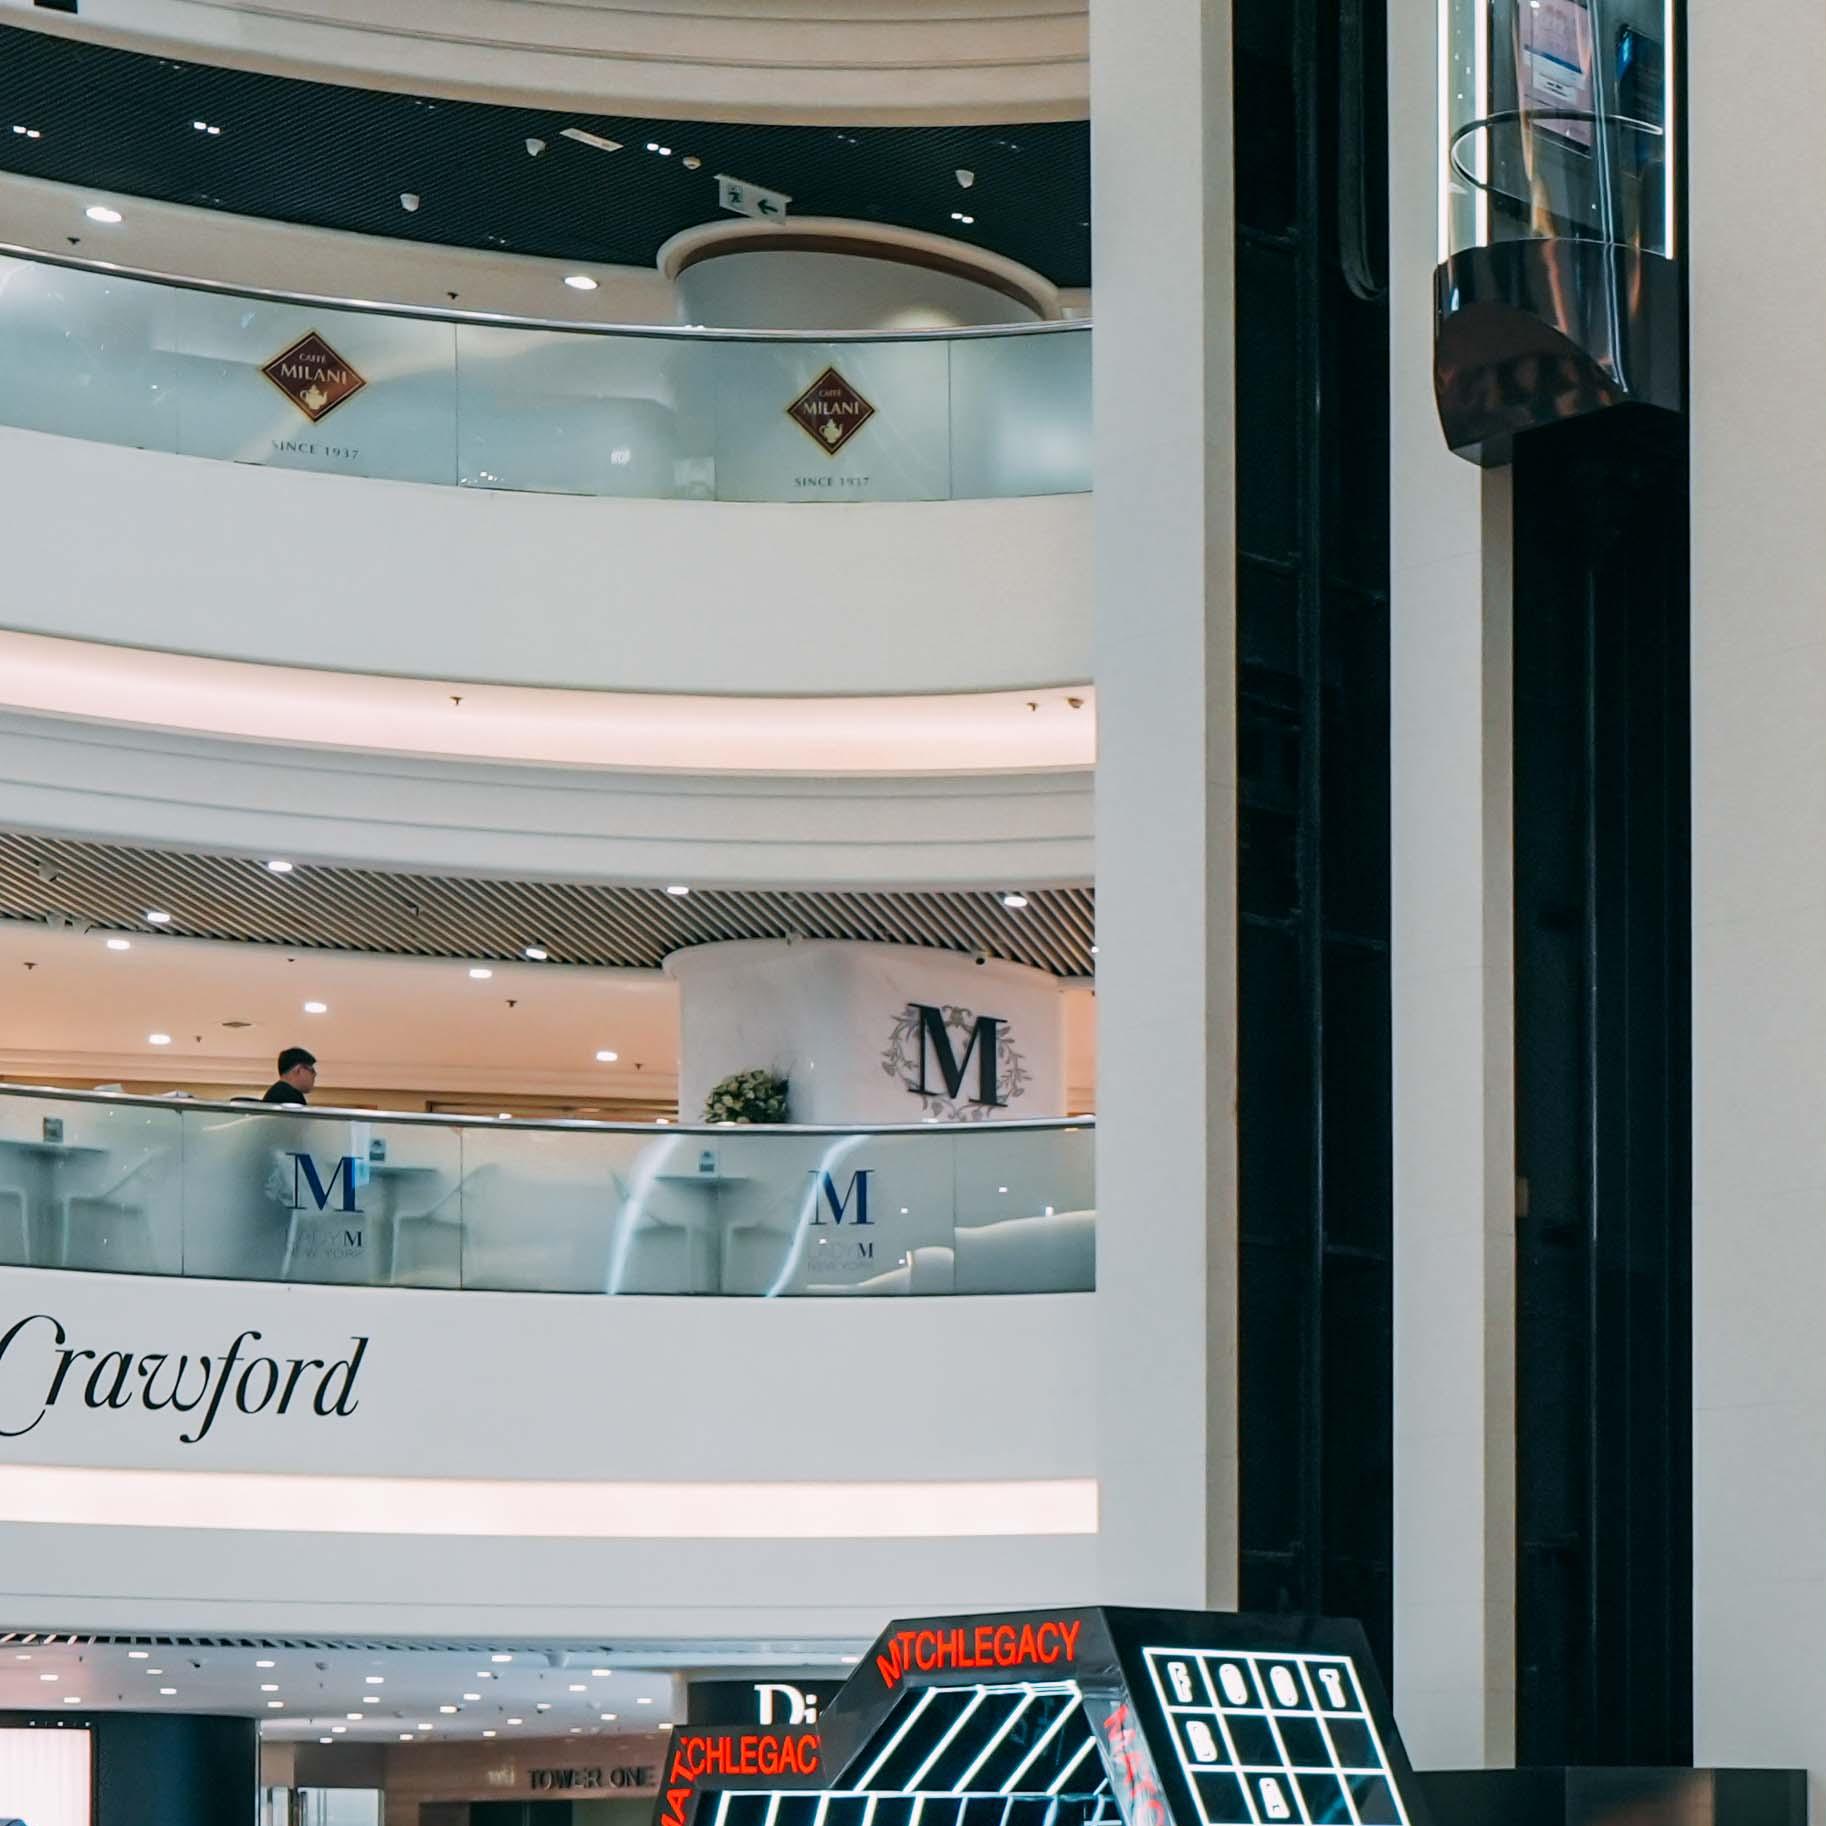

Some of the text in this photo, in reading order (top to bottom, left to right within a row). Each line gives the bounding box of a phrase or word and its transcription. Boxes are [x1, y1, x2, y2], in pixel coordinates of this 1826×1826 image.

[280, 363, 348, 385] MILANI
[803, 401, 860, 416] MILANI
[271, 439, 360, 460] SINCE 1937
[793, 476, 833, 488] SINCE
[905, 1002, 1007, 1109] M
[285, 1151, 365, 1214] M
[807, 1168, 876, 1226] M
[0, 1314, 369, 1445] Crawford
[527, 1765, 657, 1791] TOWER ONE
